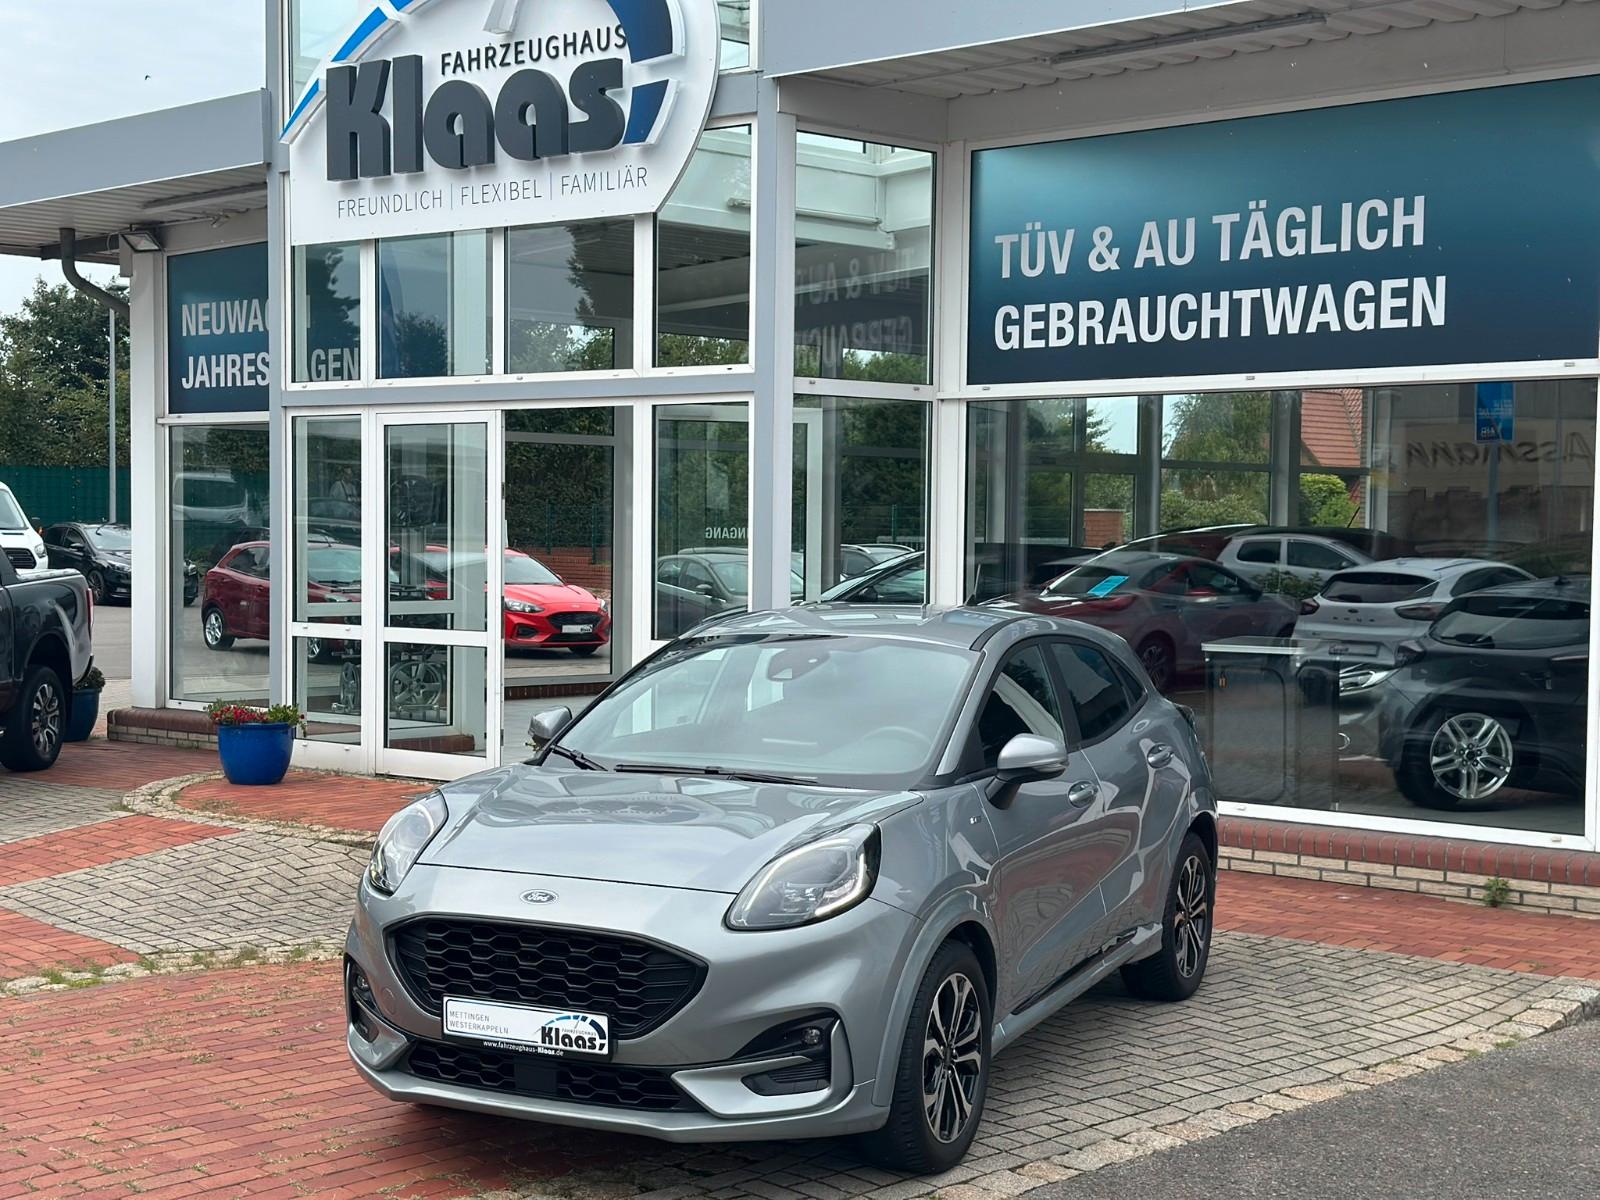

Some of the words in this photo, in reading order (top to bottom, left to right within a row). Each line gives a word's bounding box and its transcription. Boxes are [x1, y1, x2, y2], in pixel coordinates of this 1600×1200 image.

[440, 24, 628, 75] FAHRZEUGHAUS
[326, 54, 626, 181] Klaas
[337, 189, 443, 219] FREUNDLICH
[460, 178, 543, 207] FLEXIBEL
[560, 166, 649, 197] FAMILIÄR
[994, 222, 1075, 279] TÜV
[1087, 226, 1120, 272] &
[1134, 217, 1196, 268] AU
[1212, 195, 1426, 262] TÄGLICH
[994, 275, 1447, 350] GEBRAUCHTWAGEN
[449, 1010, 490, 1022] METTINGEN
[449, 1020, 509, 1034] WESTERKAPPELN
[540, 1026, 597, 1050] Klaas
